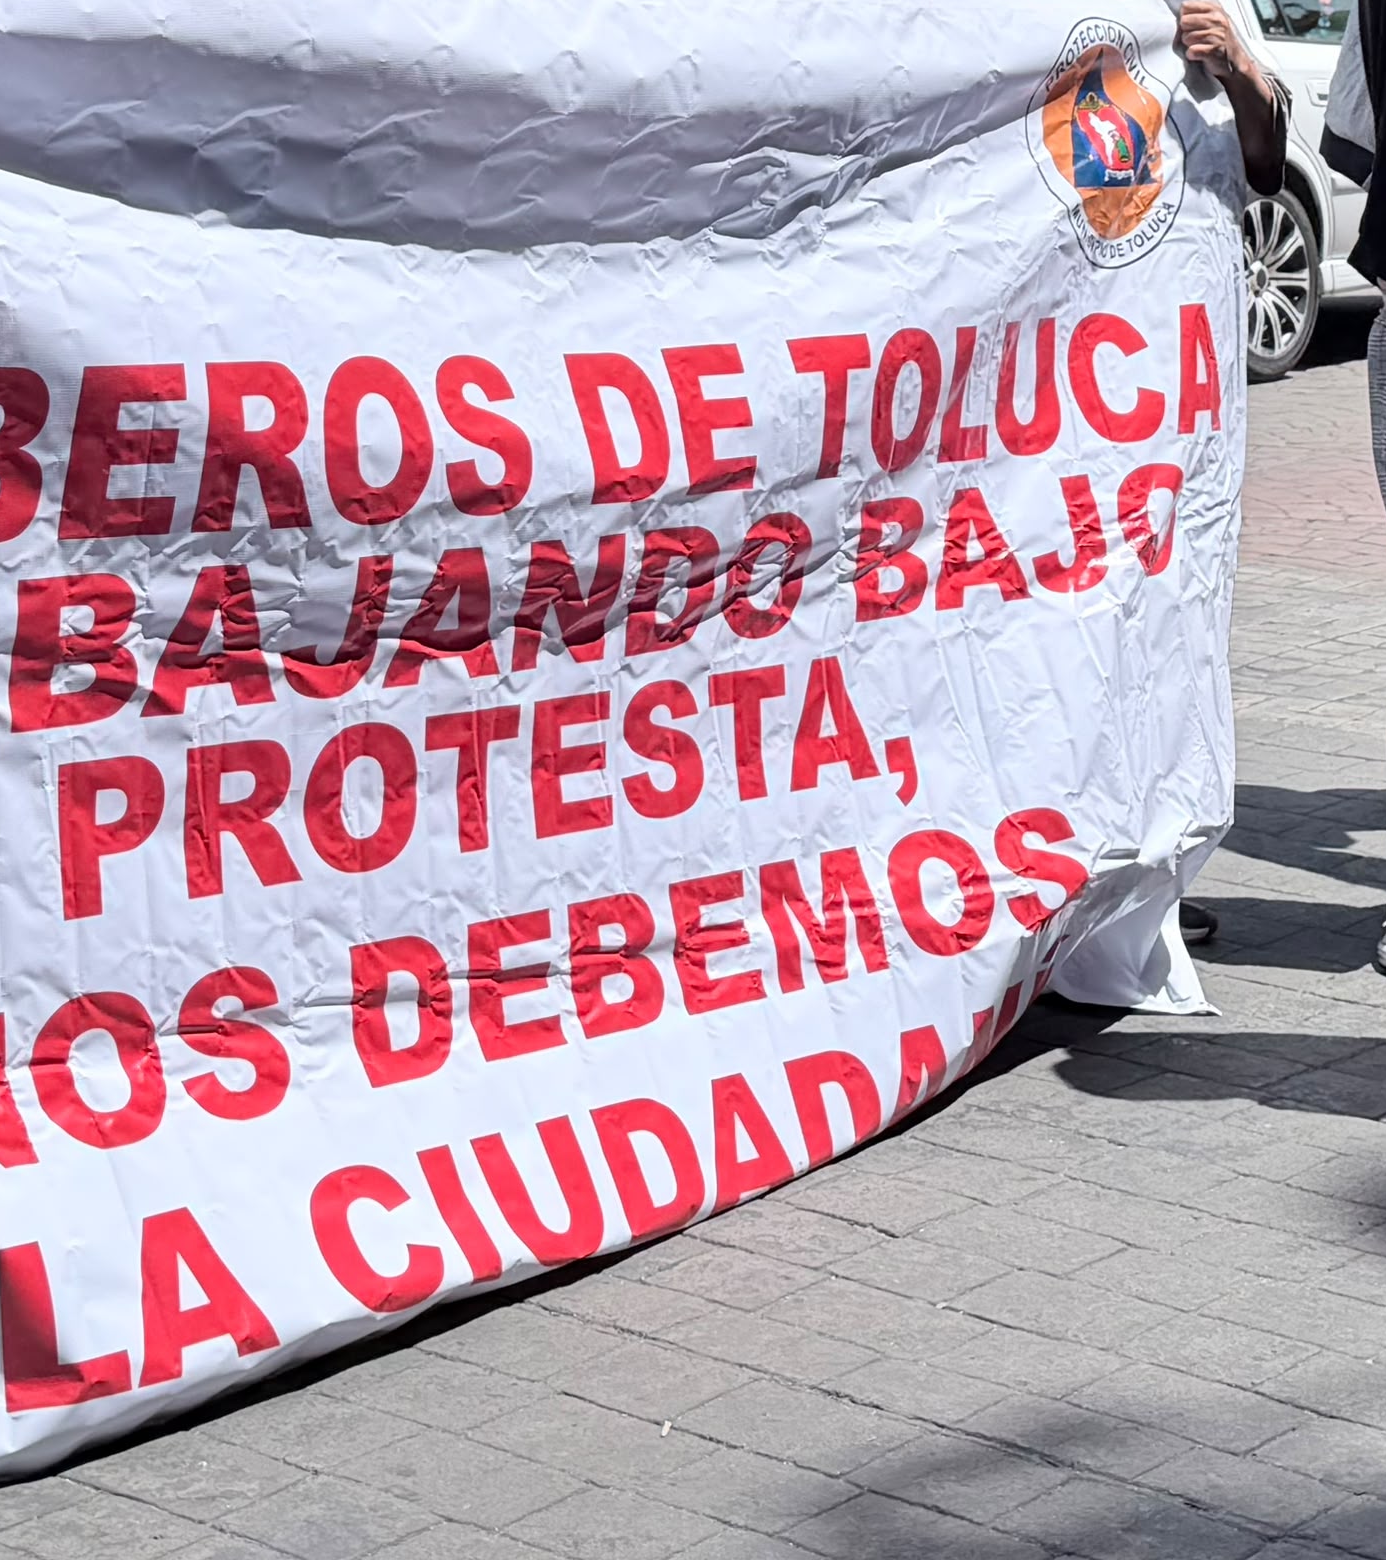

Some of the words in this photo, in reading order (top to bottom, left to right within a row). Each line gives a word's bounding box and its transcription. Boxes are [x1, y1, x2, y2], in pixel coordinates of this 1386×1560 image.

[1123, 43, 1150, 91] CIVIL
[1110, 242, 1126, 259] DE
[1127, 202, 1175, 253] TOLUCA
[564, 342, 758, 505] DE
[786, 303, 1221, 480] TOLUCA
[854, 463, 1183, 623] BAJO
[57, 655, 919, 921] PROTESTA,
[348, 807, 1089, 1089] DEBEMOS
